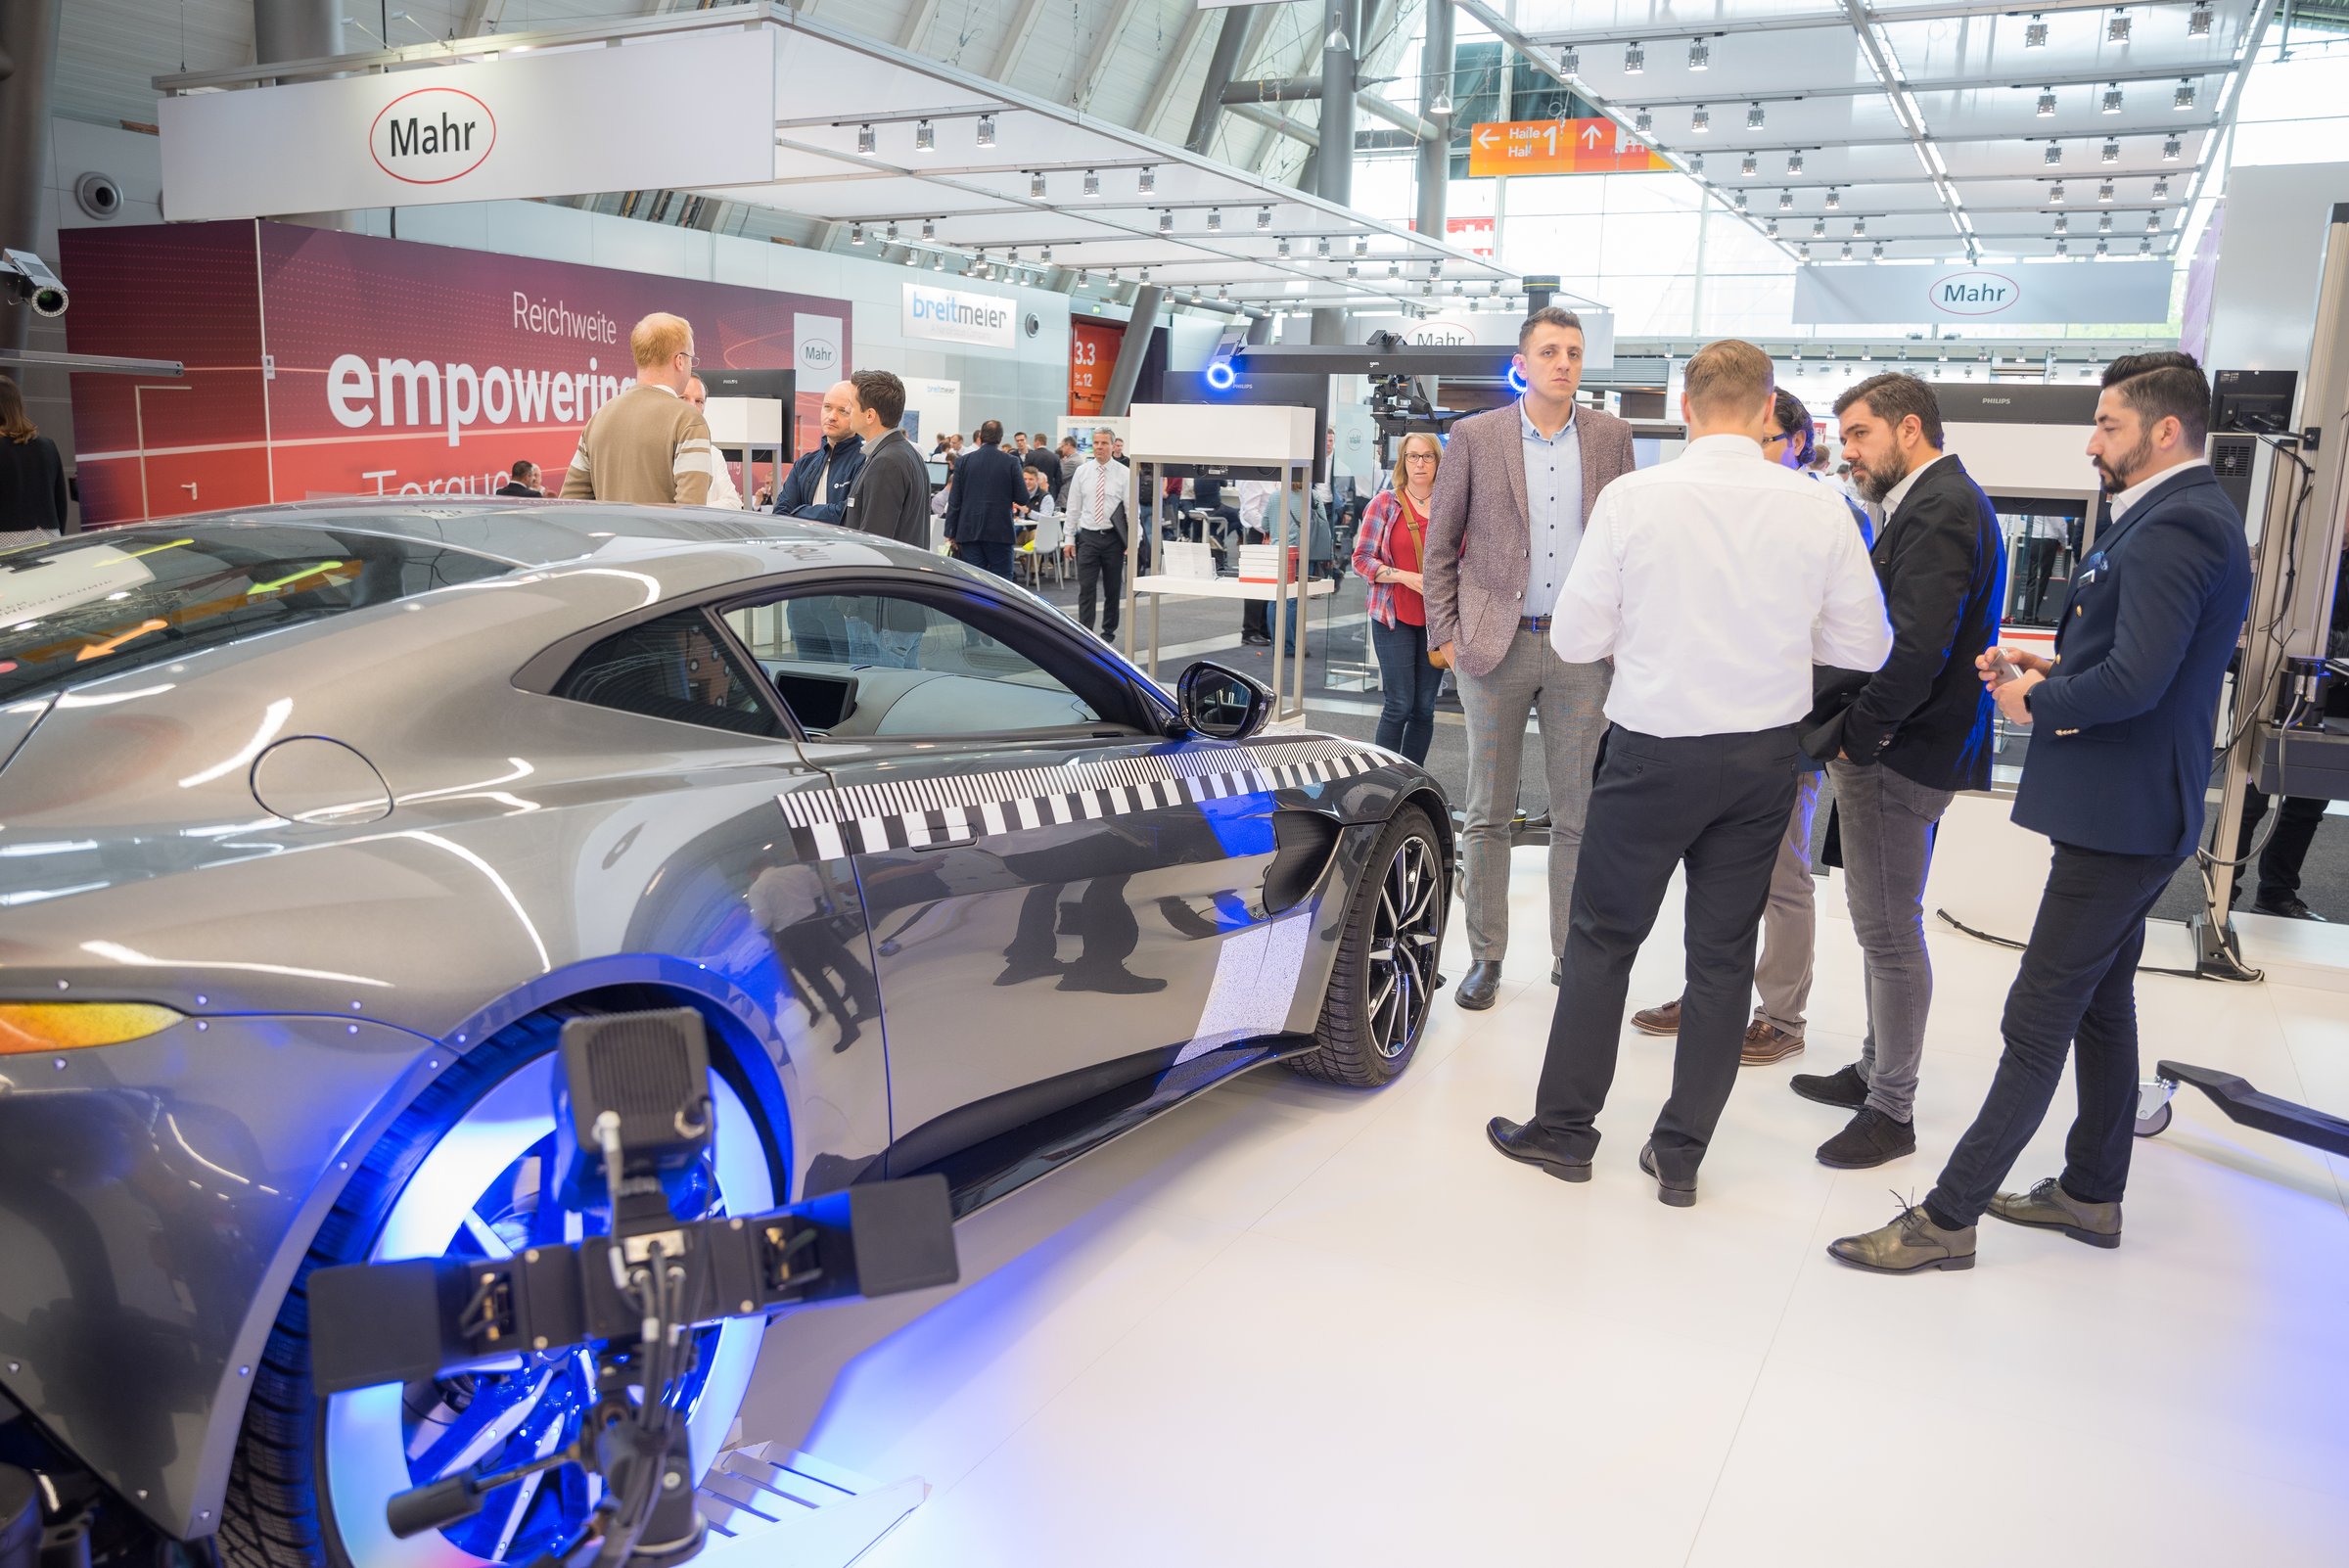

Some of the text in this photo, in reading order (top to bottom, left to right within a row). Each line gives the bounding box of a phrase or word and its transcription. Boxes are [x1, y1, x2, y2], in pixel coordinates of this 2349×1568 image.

[391, 112, 476, 157] Mahr
[1543, 125, 1557, 157] 1
[1944, 283, 2005, 302] Mahr
[513, 291, 617, 345] Reichweite
[912, 291, 1006, 329] breitmeier
[1416, 332, 1465, 346] Mahr
[806, 346, 832, 361] Mahr
[1076, 342, 1095, 366] 3.3
[1083, 373, 1092, 387] 12
